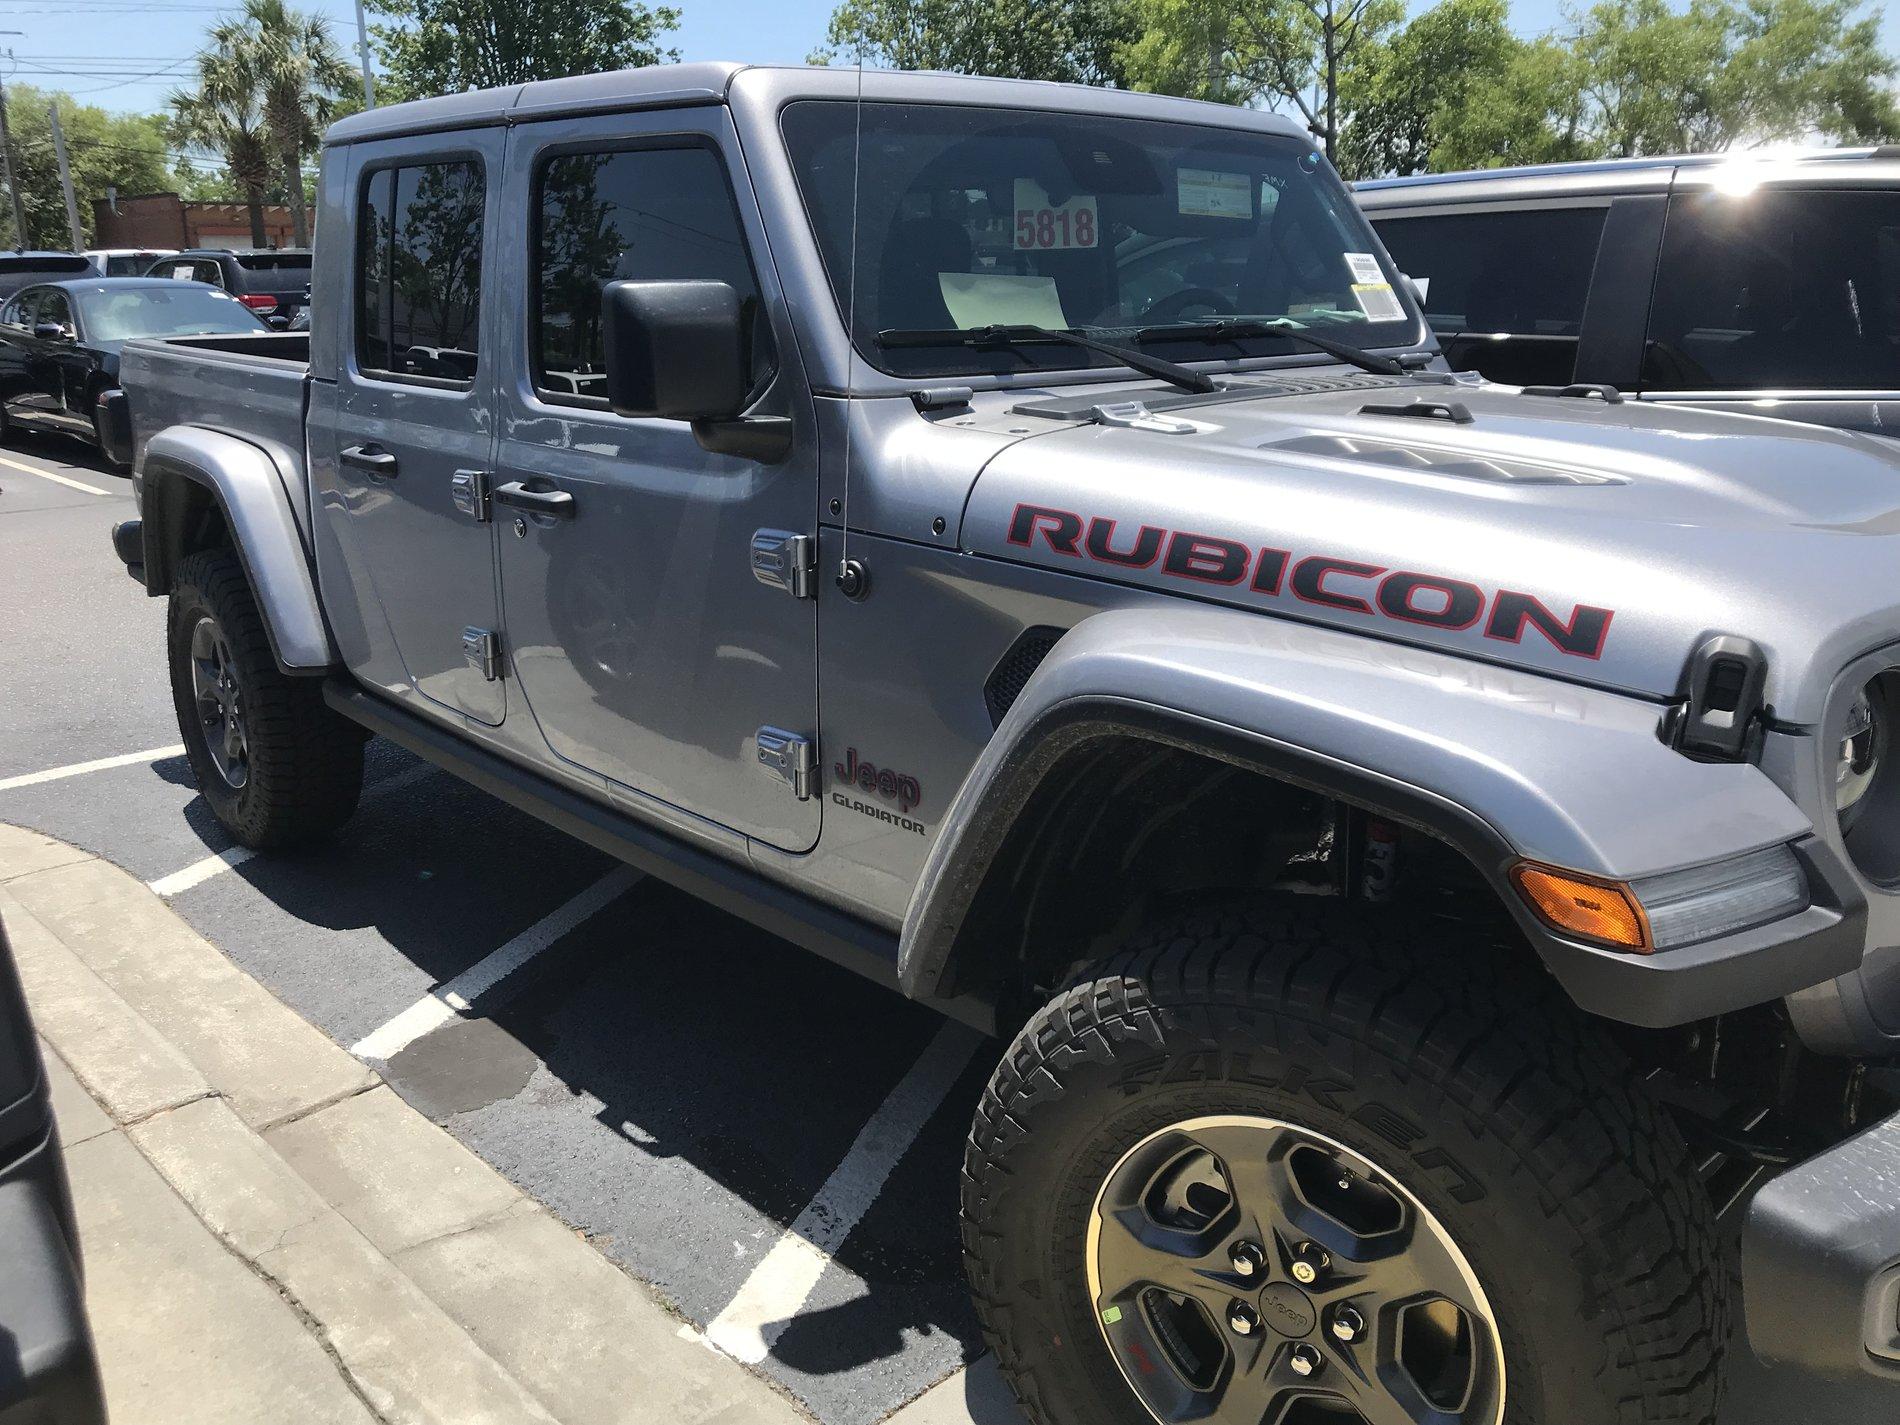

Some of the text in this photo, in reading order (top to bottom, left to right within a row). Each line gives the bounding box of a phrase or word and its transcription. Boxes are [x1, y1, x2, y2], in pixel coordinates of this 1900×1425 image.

[1016, 208, 1095, 248] 5818
[1006, 503, 1615, 661] RUBICON
[834, 746, 921, 813] Jeep
[832, 792, 926, 836] GLADIATOR
[1107, 1048, 1490, 1205] FALKEN
[1265, 1295, 1308, 1327] Jeep
